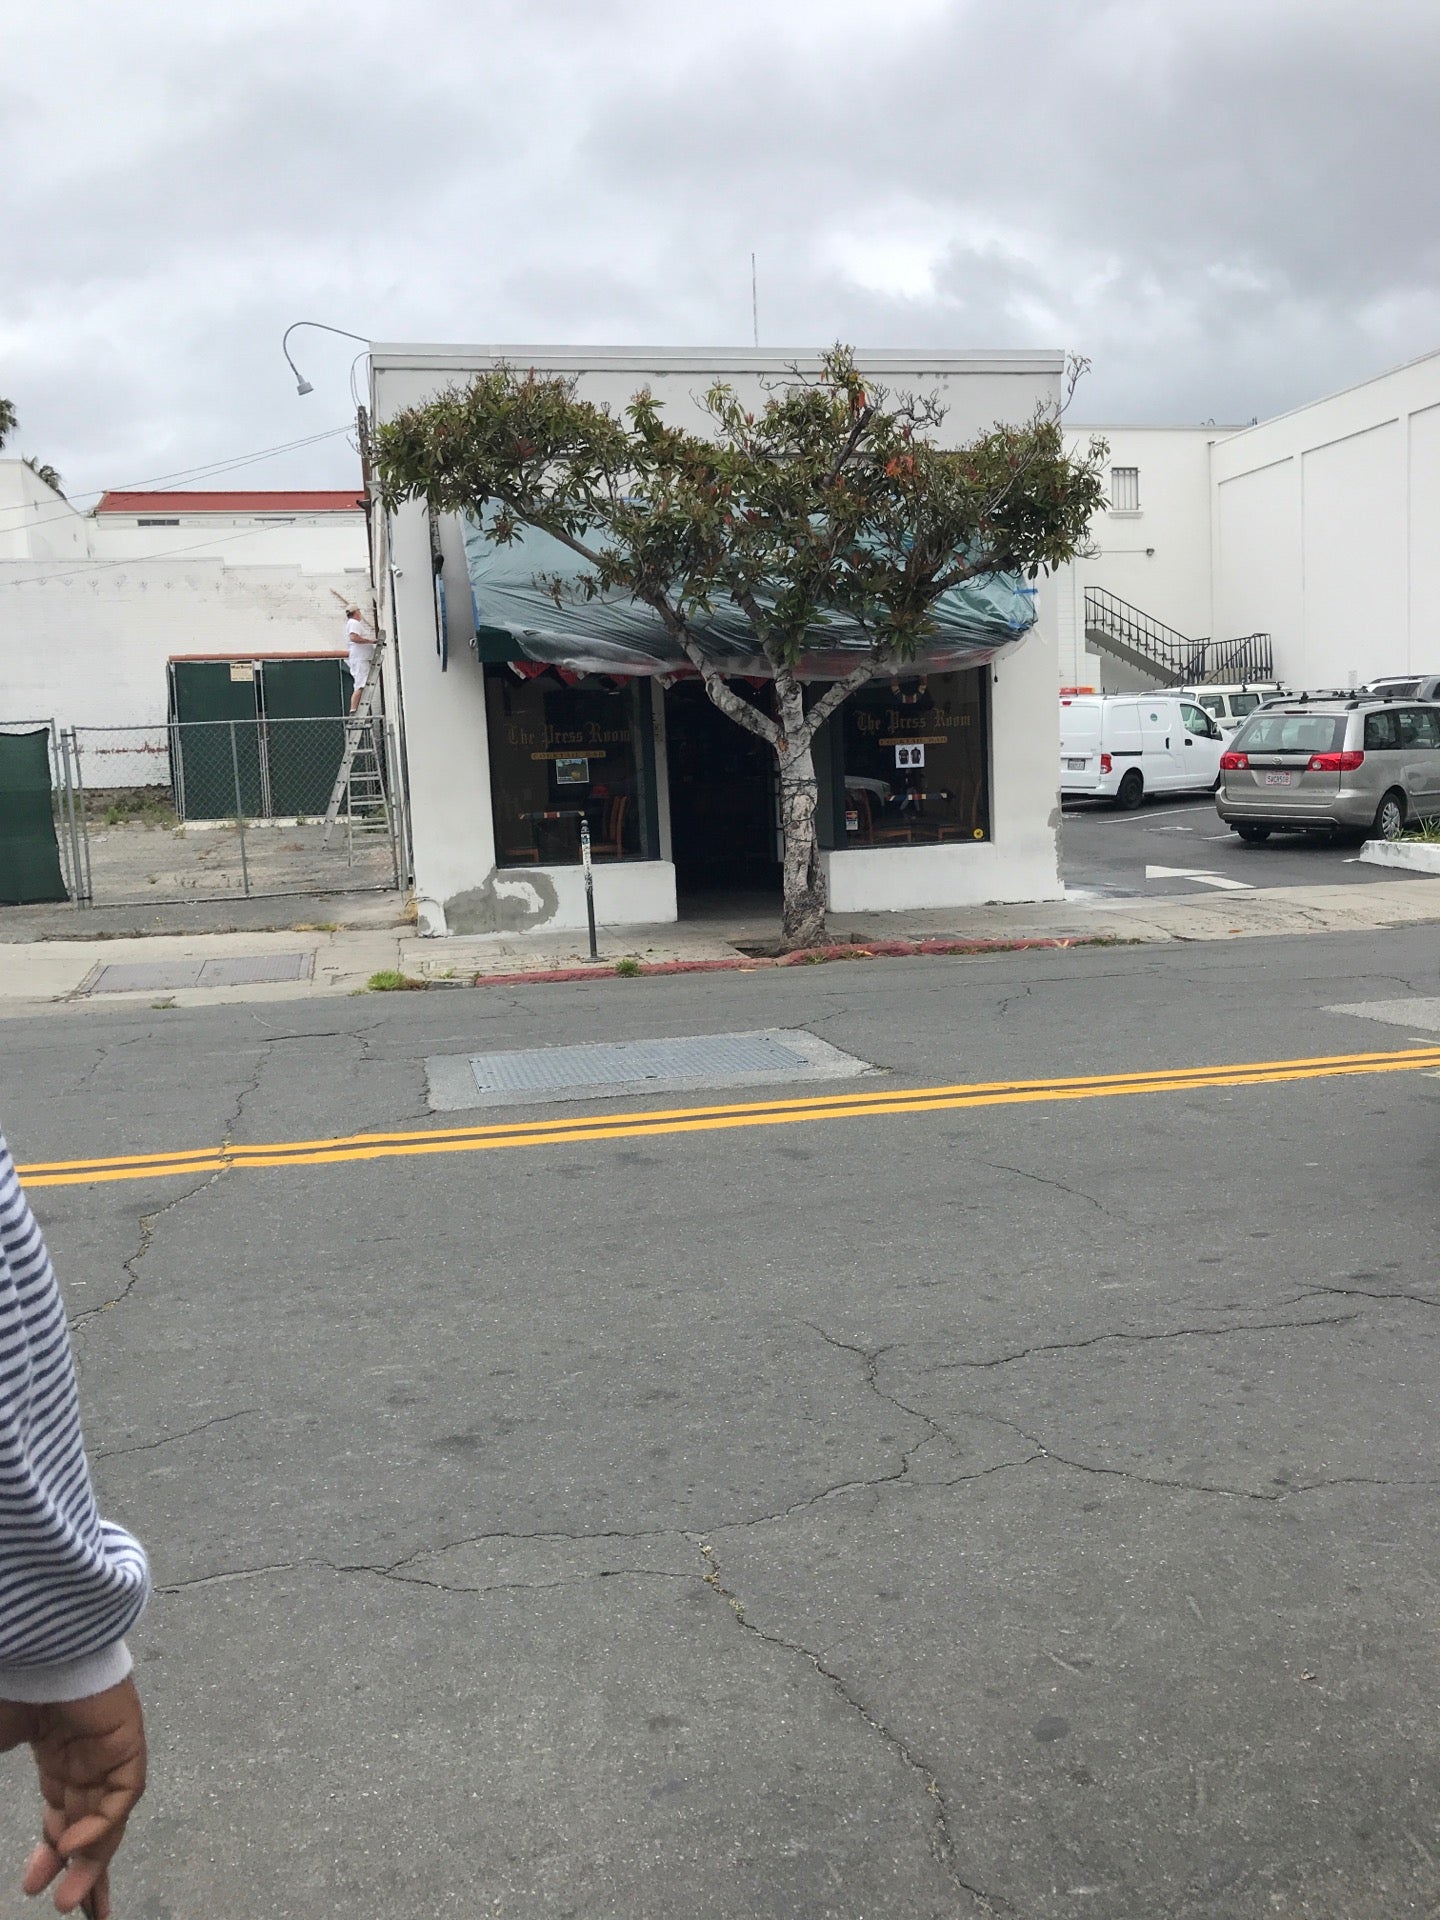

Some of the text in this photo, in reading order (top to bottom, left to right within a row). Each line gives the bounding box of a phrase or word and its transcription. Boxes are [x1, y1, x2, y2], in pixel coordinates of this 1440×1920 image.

[854, 706, 972, 733] The Press Room
[505, 721, 631, 747] The Press Room
